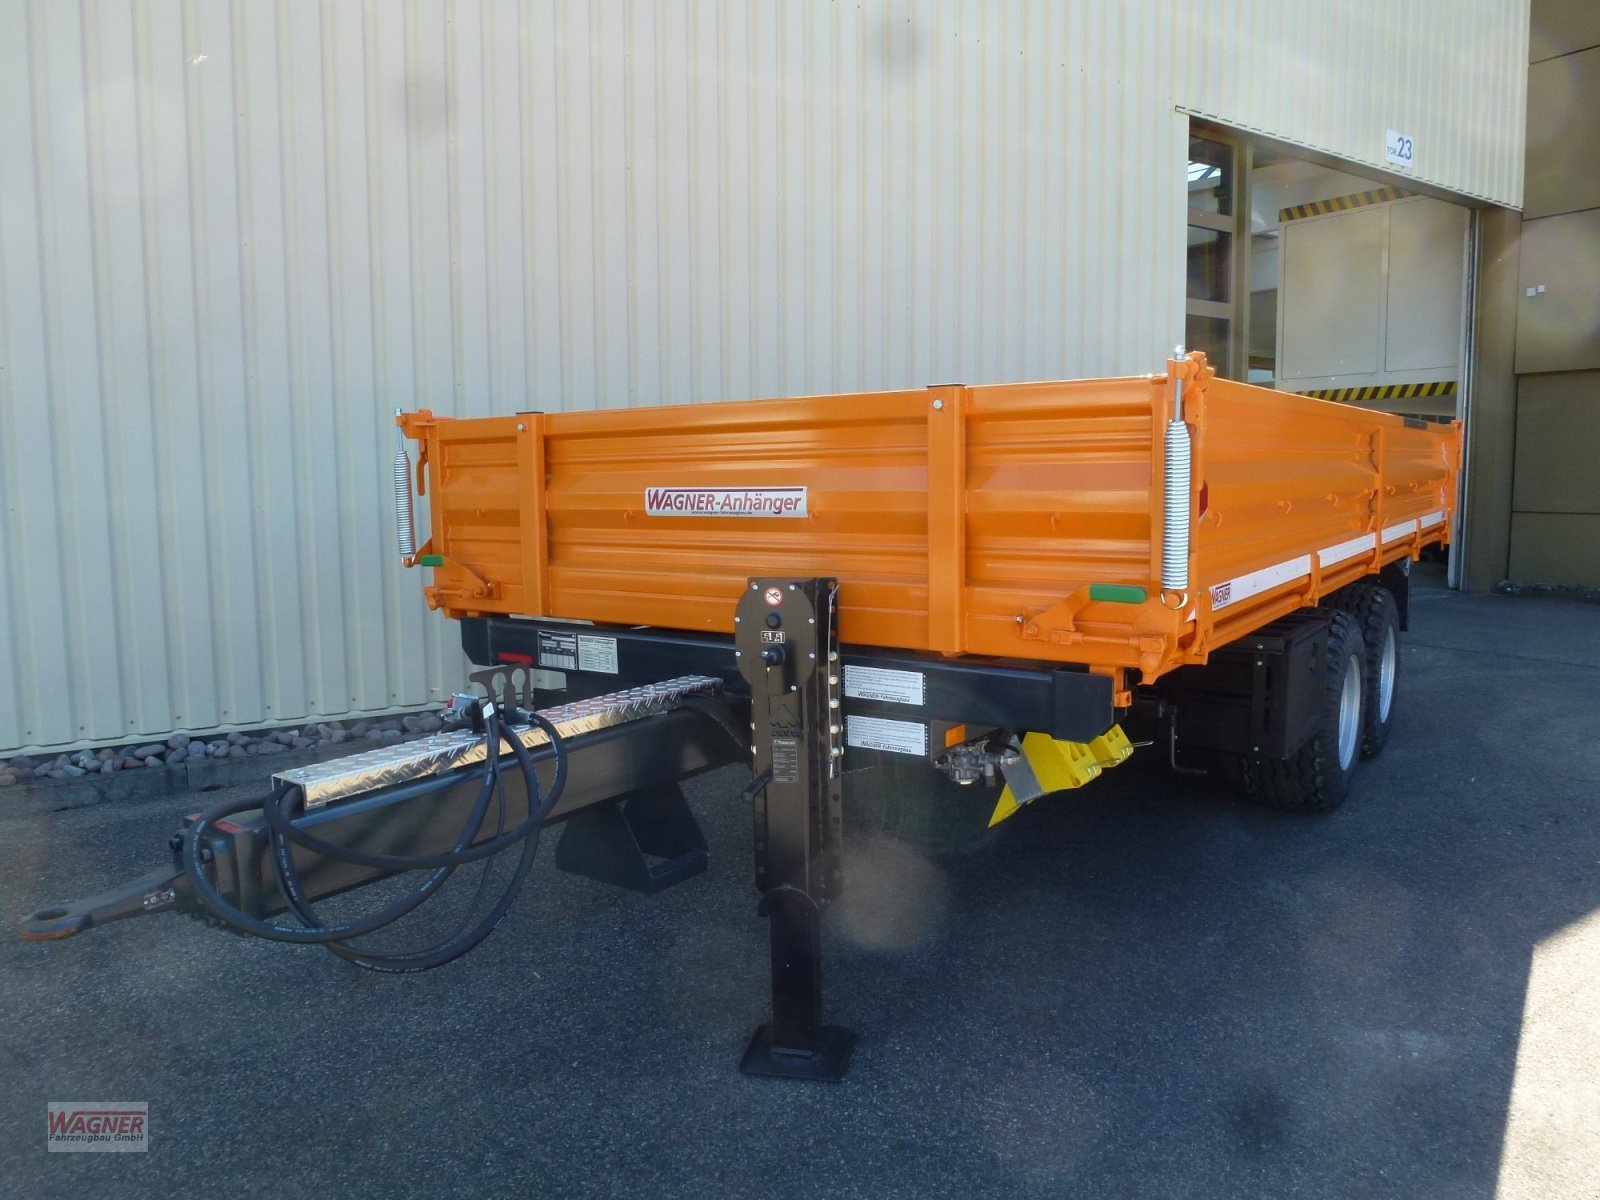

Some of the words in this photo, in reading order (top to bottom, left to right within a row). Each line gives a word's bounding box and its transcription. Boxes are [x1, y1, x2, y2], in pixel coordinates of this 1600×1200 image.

[1397, 137, 1412, 160] 23
[648, 488, 803, 515] WAGNER-Anhänger
[1211, 583, 1231, 606] WAGNER
